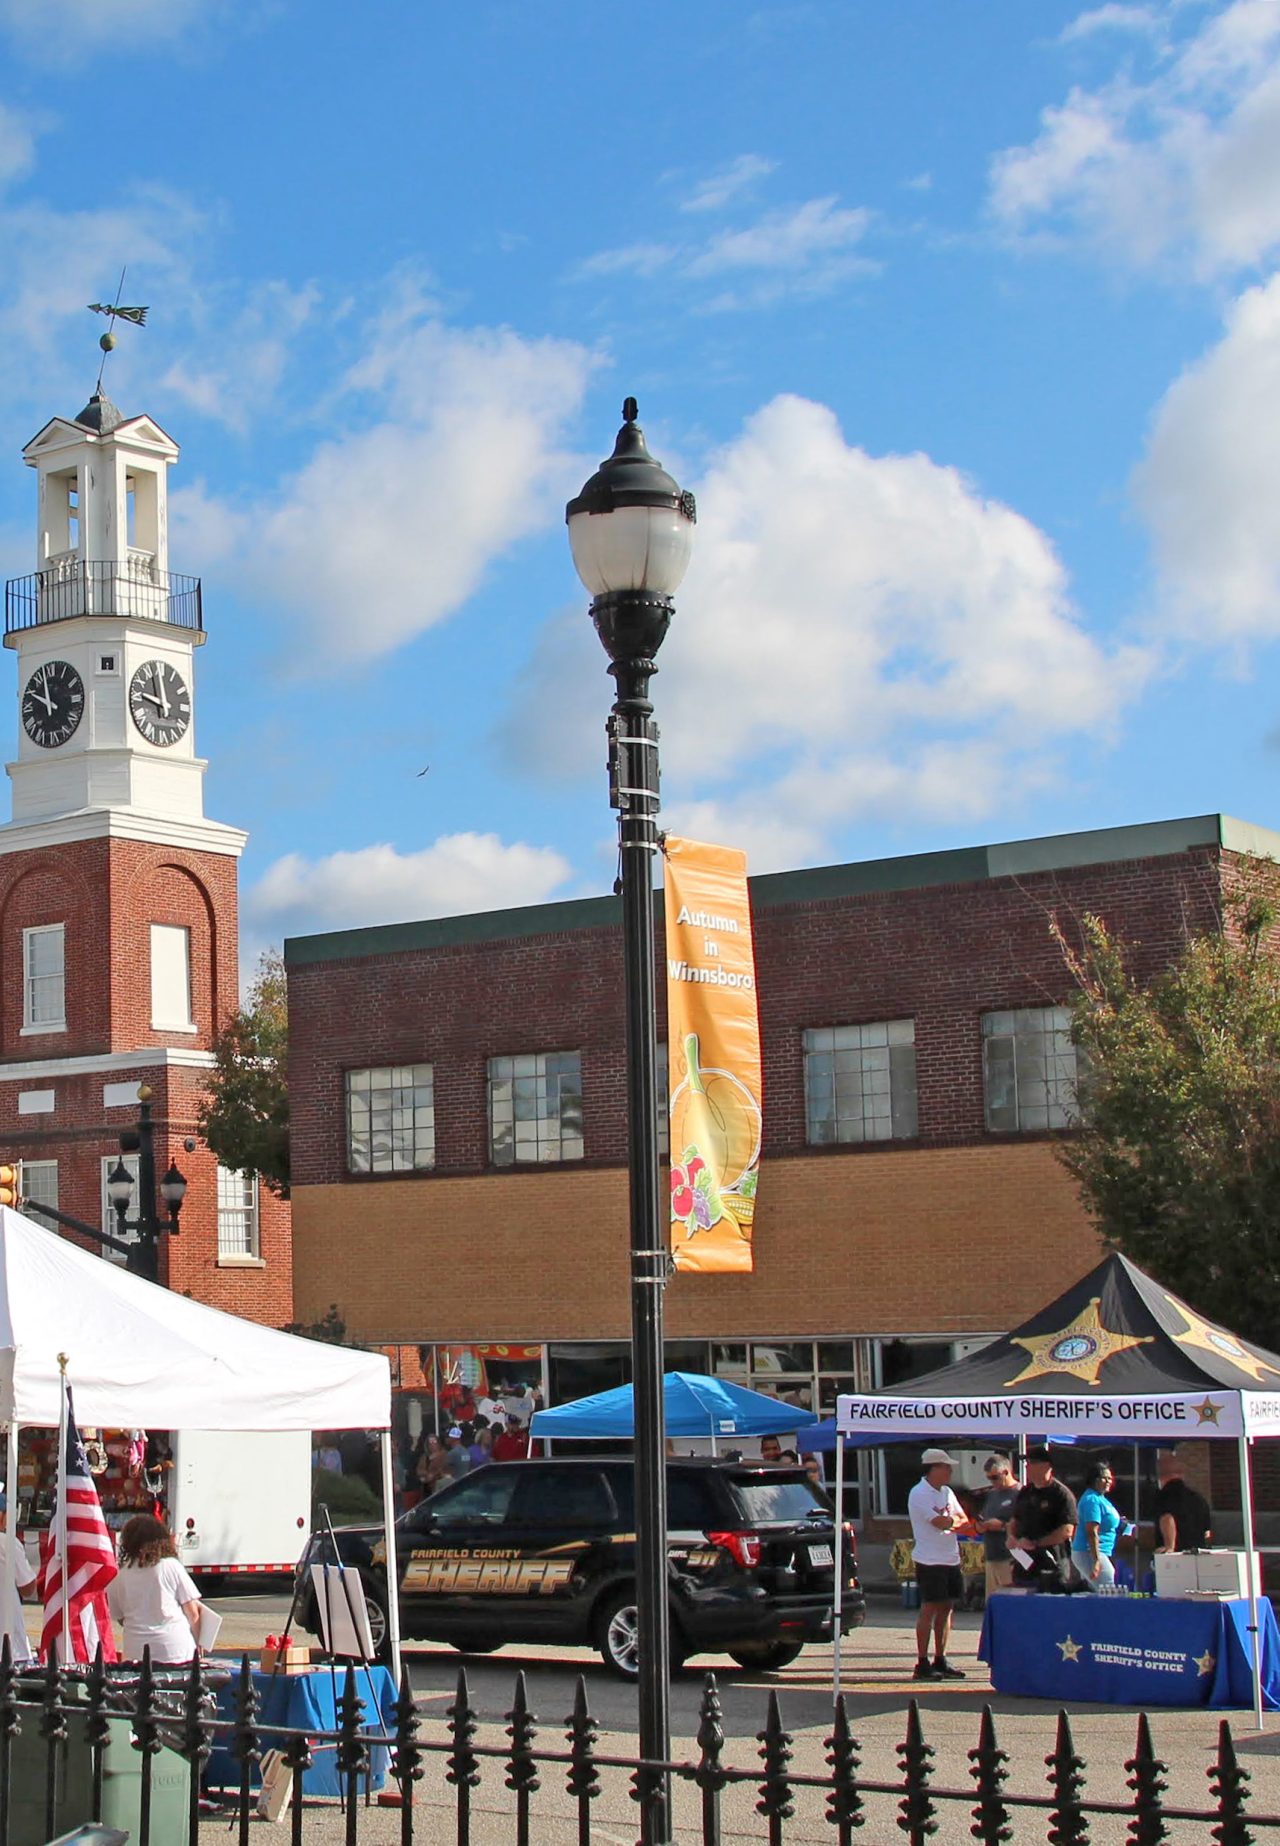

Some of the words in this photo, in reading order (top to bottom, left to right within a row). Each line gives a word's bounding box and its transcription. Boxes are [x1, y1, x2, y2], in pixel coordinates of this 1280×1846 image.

[676, 904, 738, 933] Autumn
[704, 935, 719, 956] in
[668, 958, 753, 989] Winnsboro
[851, 1402, 935, 1419] FAIRFIELD
[941, 1400, 1014, 1419] COUNTY
[1020, 1400, 1113, 1419] SHERIFF'S
[1118, 1402, 1186, 1420] OFFICE
[410, 1548, 469, 1559] FAIRFIELD
[472, 1548, 521, 1559] COUNTY
[687, 1551, 720, 1568] 911
[399, 1559, 576, 1594] SHERIFF
[1090, 1642, 1142, 1657] FAIRFIELD
[1144, 1649, 1187, 1661] COUNTY
[1144, 1661, 1184, 1673] OFFICE
